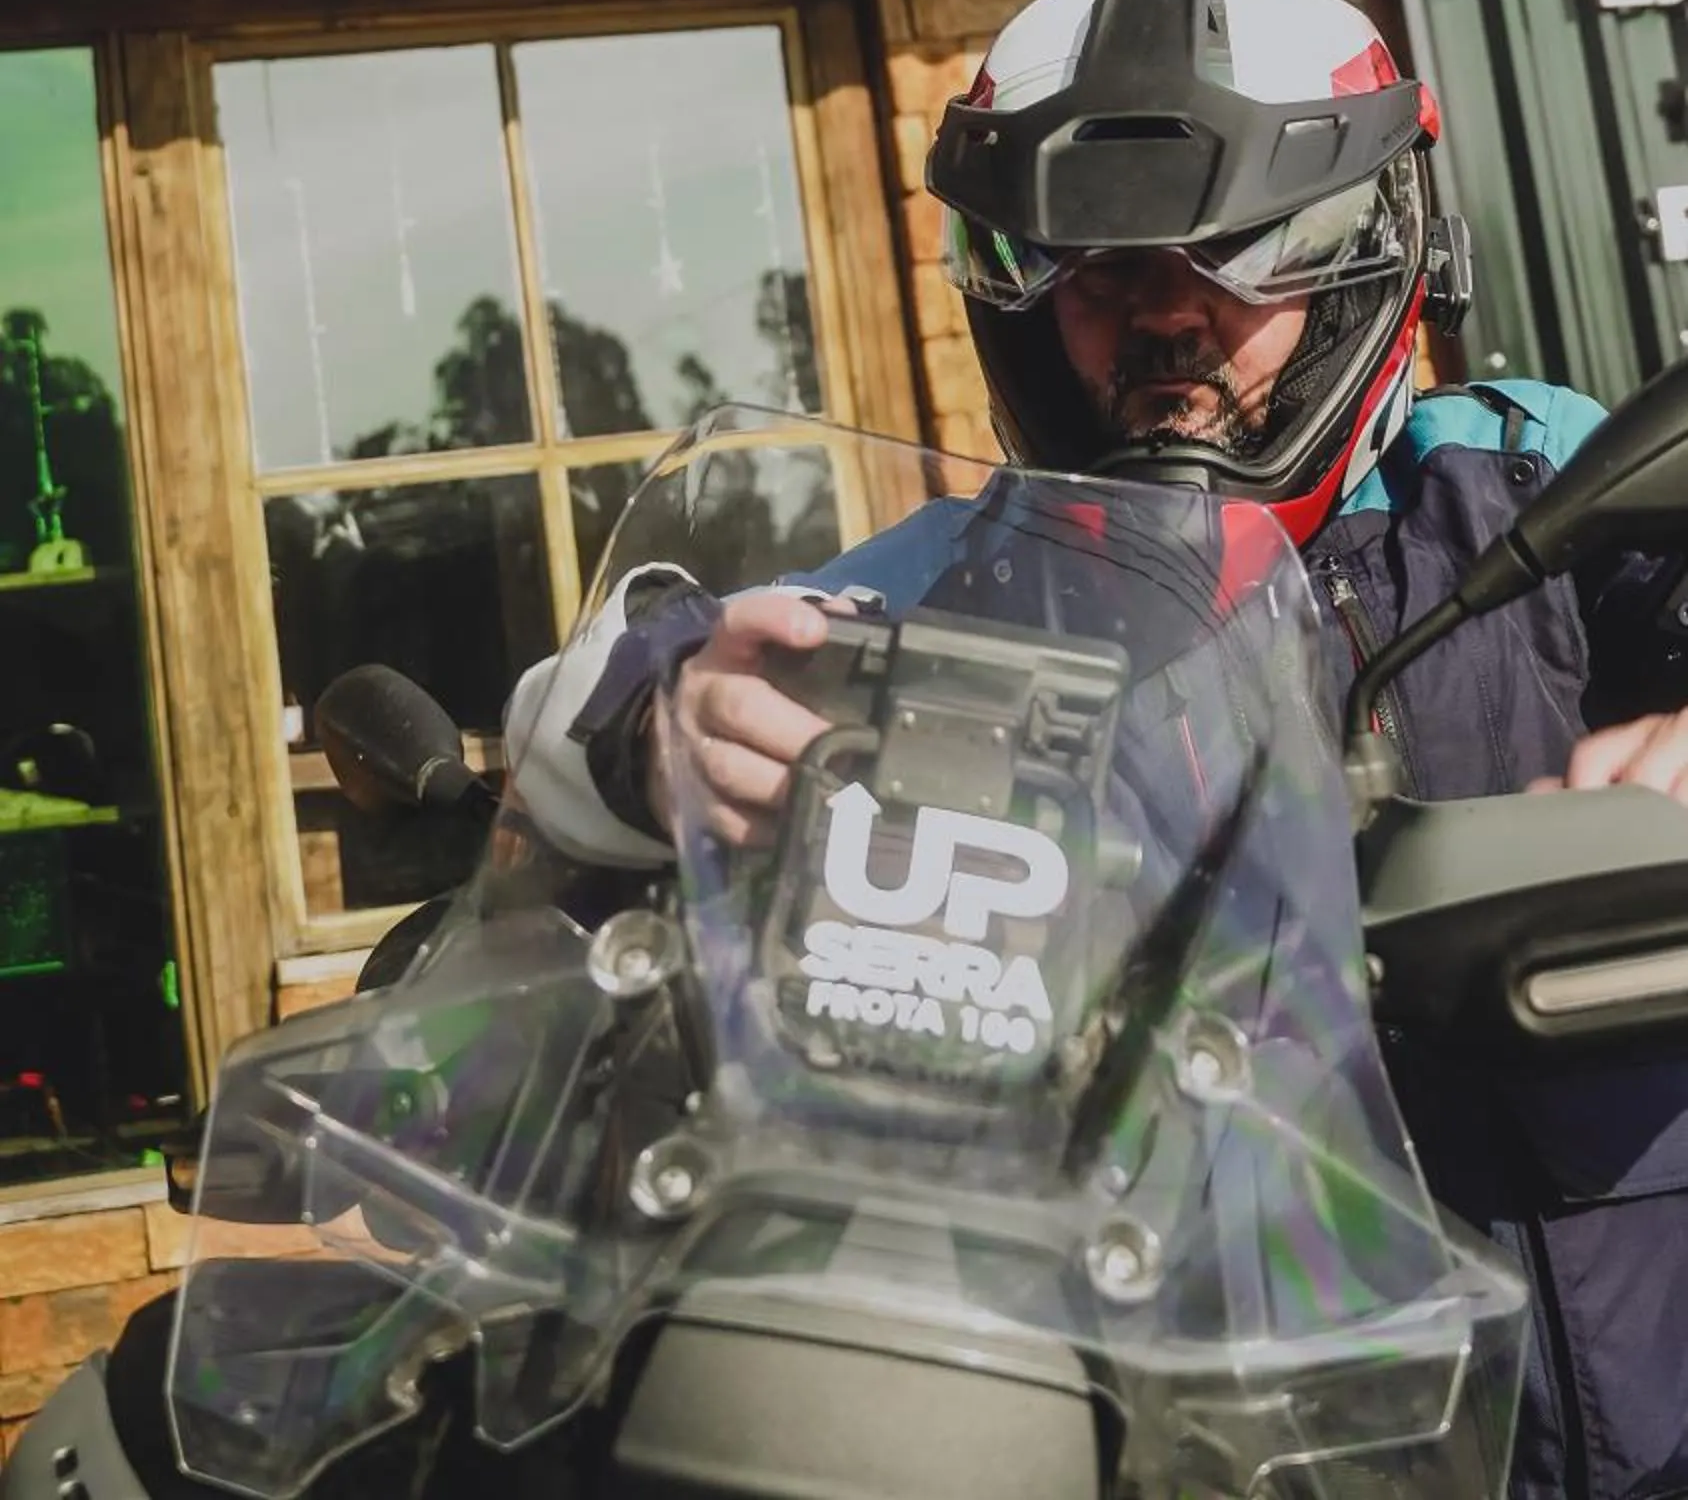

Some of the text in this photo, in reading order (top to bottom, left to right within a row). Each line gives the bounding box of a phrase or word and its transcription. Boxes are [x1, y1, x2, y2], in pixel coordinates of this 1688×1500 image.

[825, 781, 1069, 941] UP
[799, 920, 1053, 1021] SERRA
[806, 980, 945, 1037] FROTA
